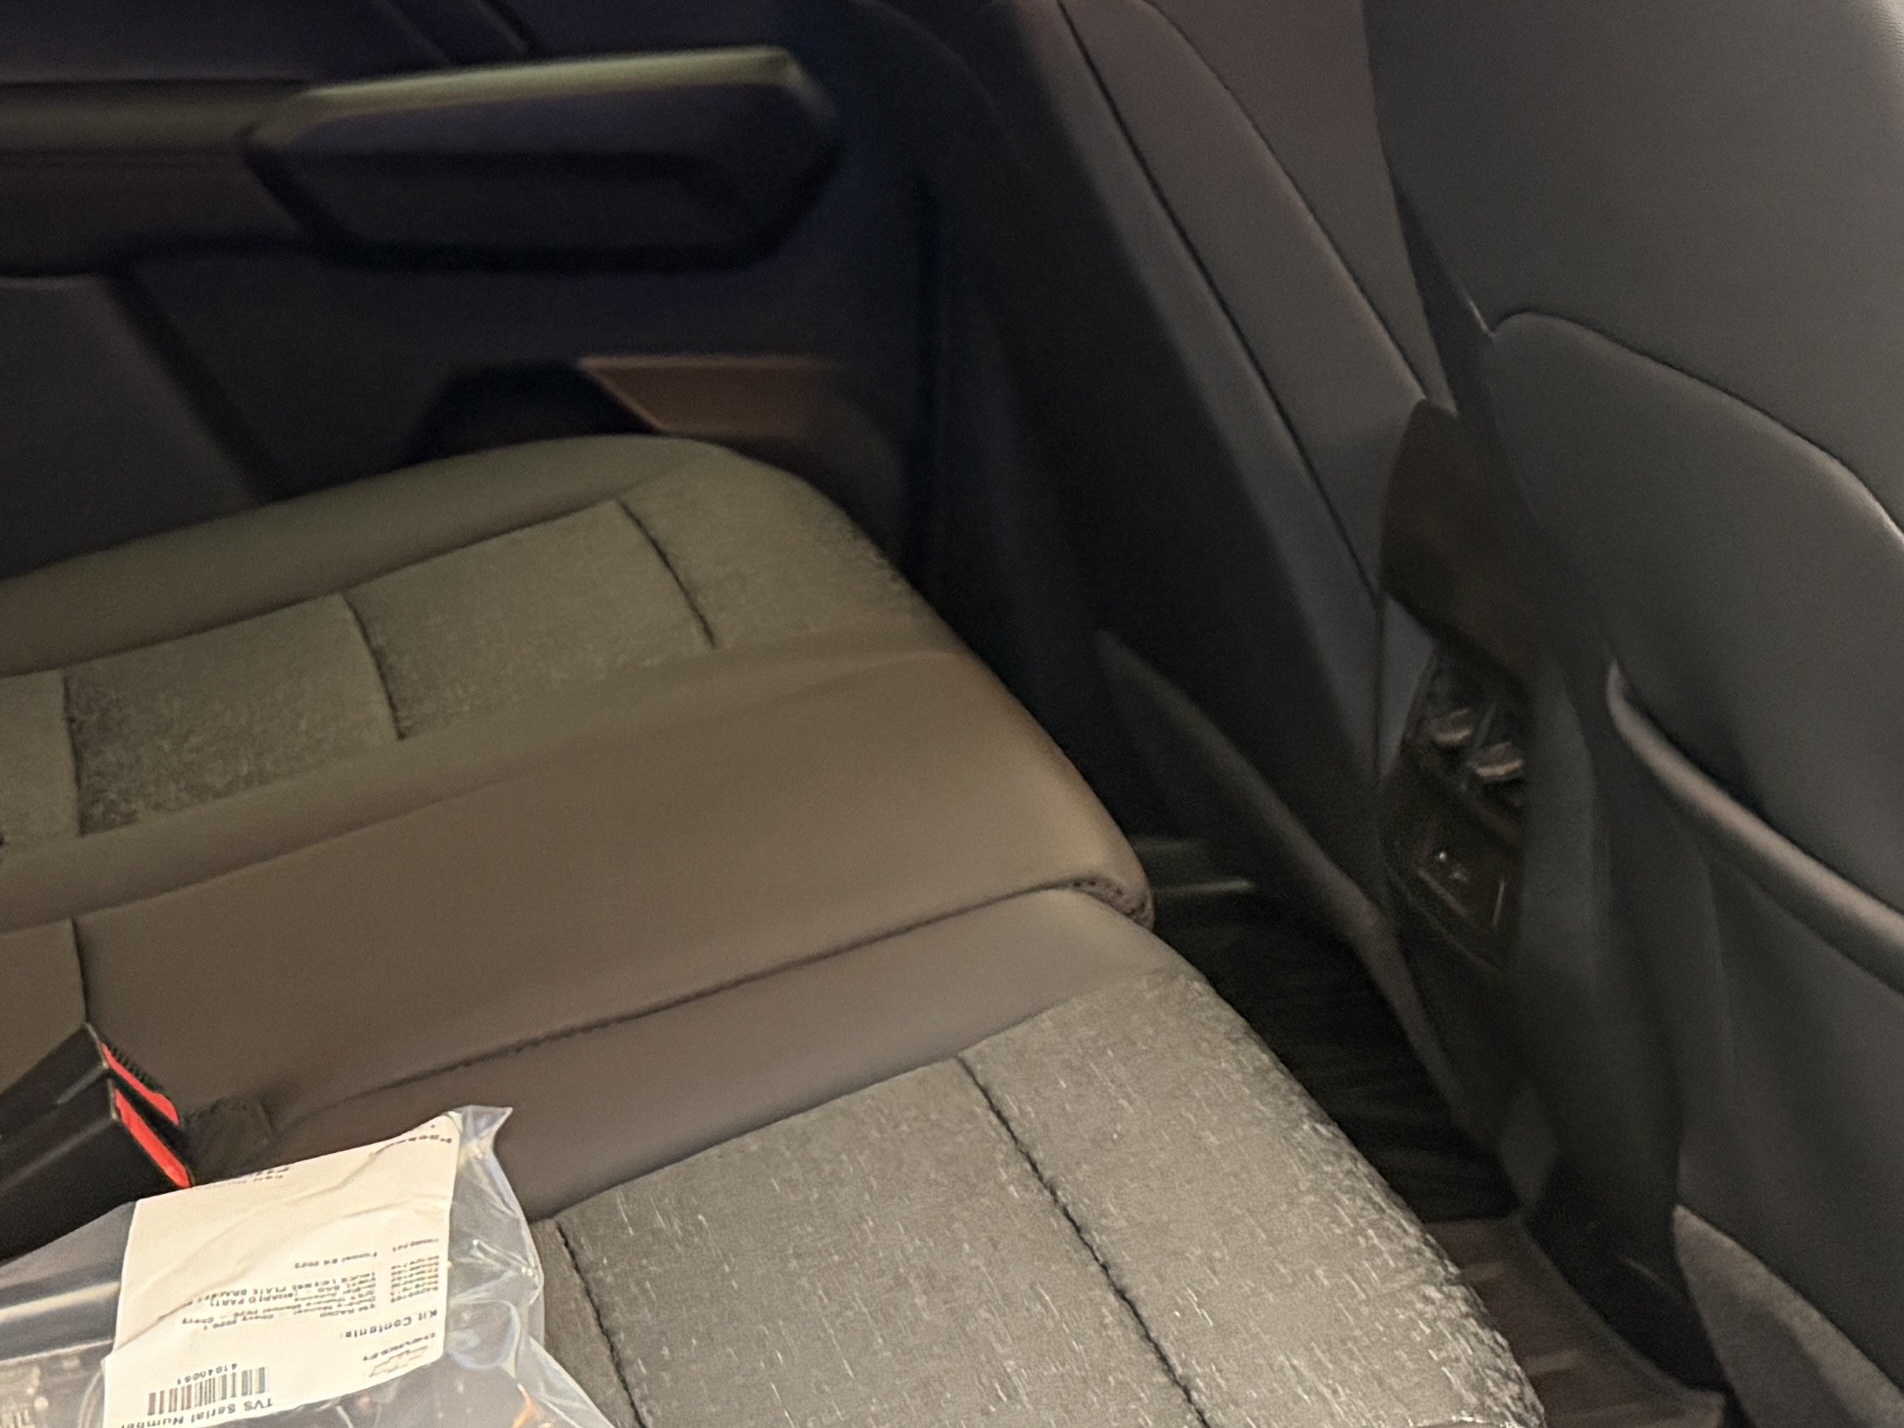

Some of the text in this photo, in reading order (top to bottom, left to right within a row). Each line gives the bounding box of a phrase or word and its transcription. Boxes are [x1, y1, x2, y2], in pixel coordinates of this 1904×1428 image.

[418, 1309, 438, 1321] Kit
[244, 1397, 273, 1412] TVS
[190, 1403, 236, 1423] Serial
